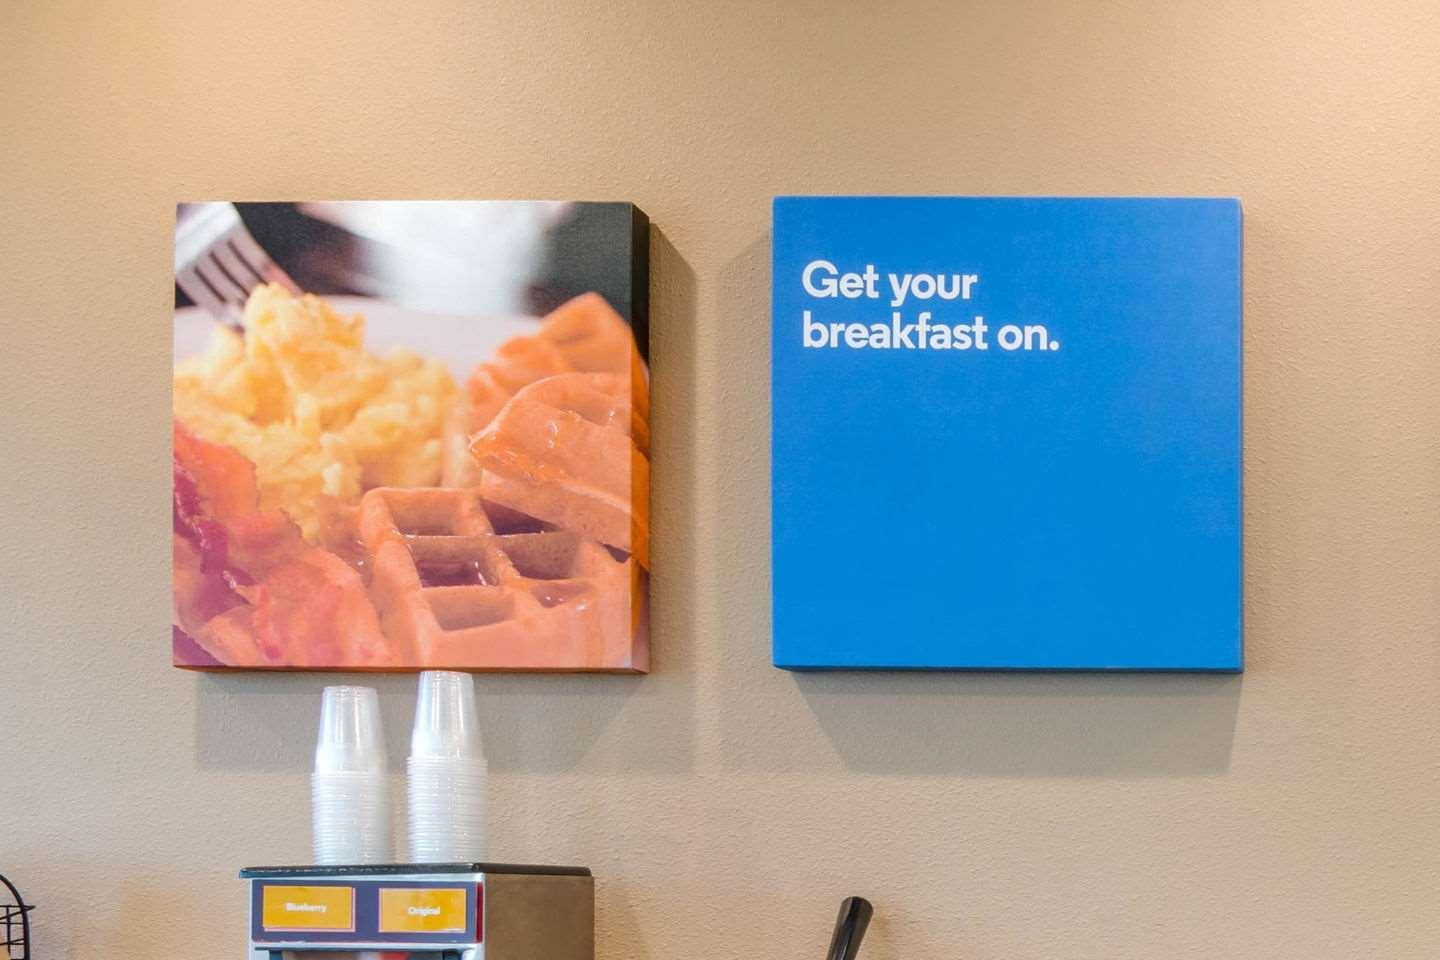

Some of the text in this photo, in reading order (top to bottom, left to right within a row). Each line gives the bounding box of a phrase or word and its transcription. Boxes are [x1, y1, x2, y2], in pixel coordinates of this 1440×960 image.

[802, 260, 977, 307] Get your
[802, 311, 1060, 350] breakfast on.
[286, 902, 327, 913] Blueberry
[407, 905, 440, 916] Original
